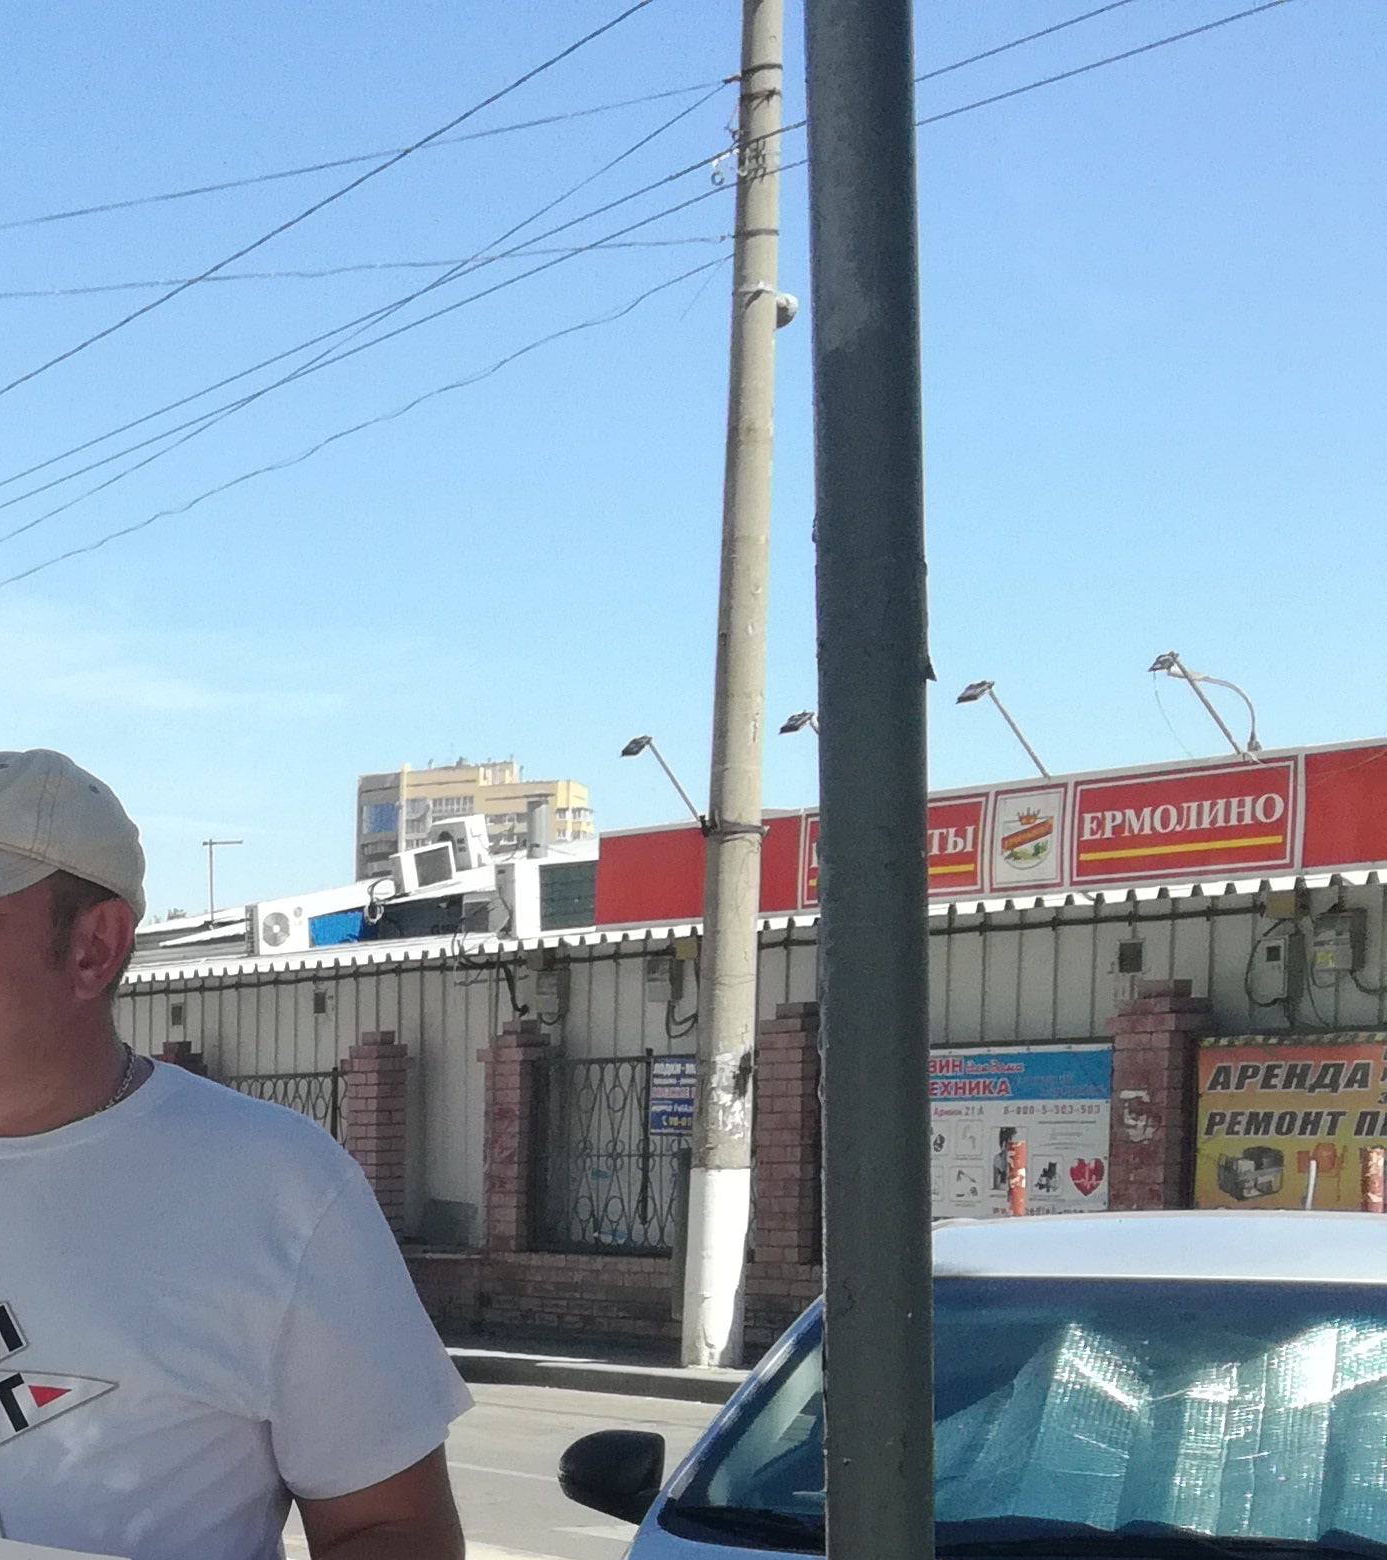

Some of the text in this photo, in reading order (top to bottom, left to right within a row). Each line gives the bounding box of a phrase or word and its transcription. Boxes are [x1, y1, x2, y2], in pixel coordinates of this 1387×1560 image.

[1080, 793, 1285, 841] ЕРМОЛИНО
[1206, 1062, 1372, 1094] АРЕНДА
[1204, 1110, 1347, 1136] РЕМОНТ
